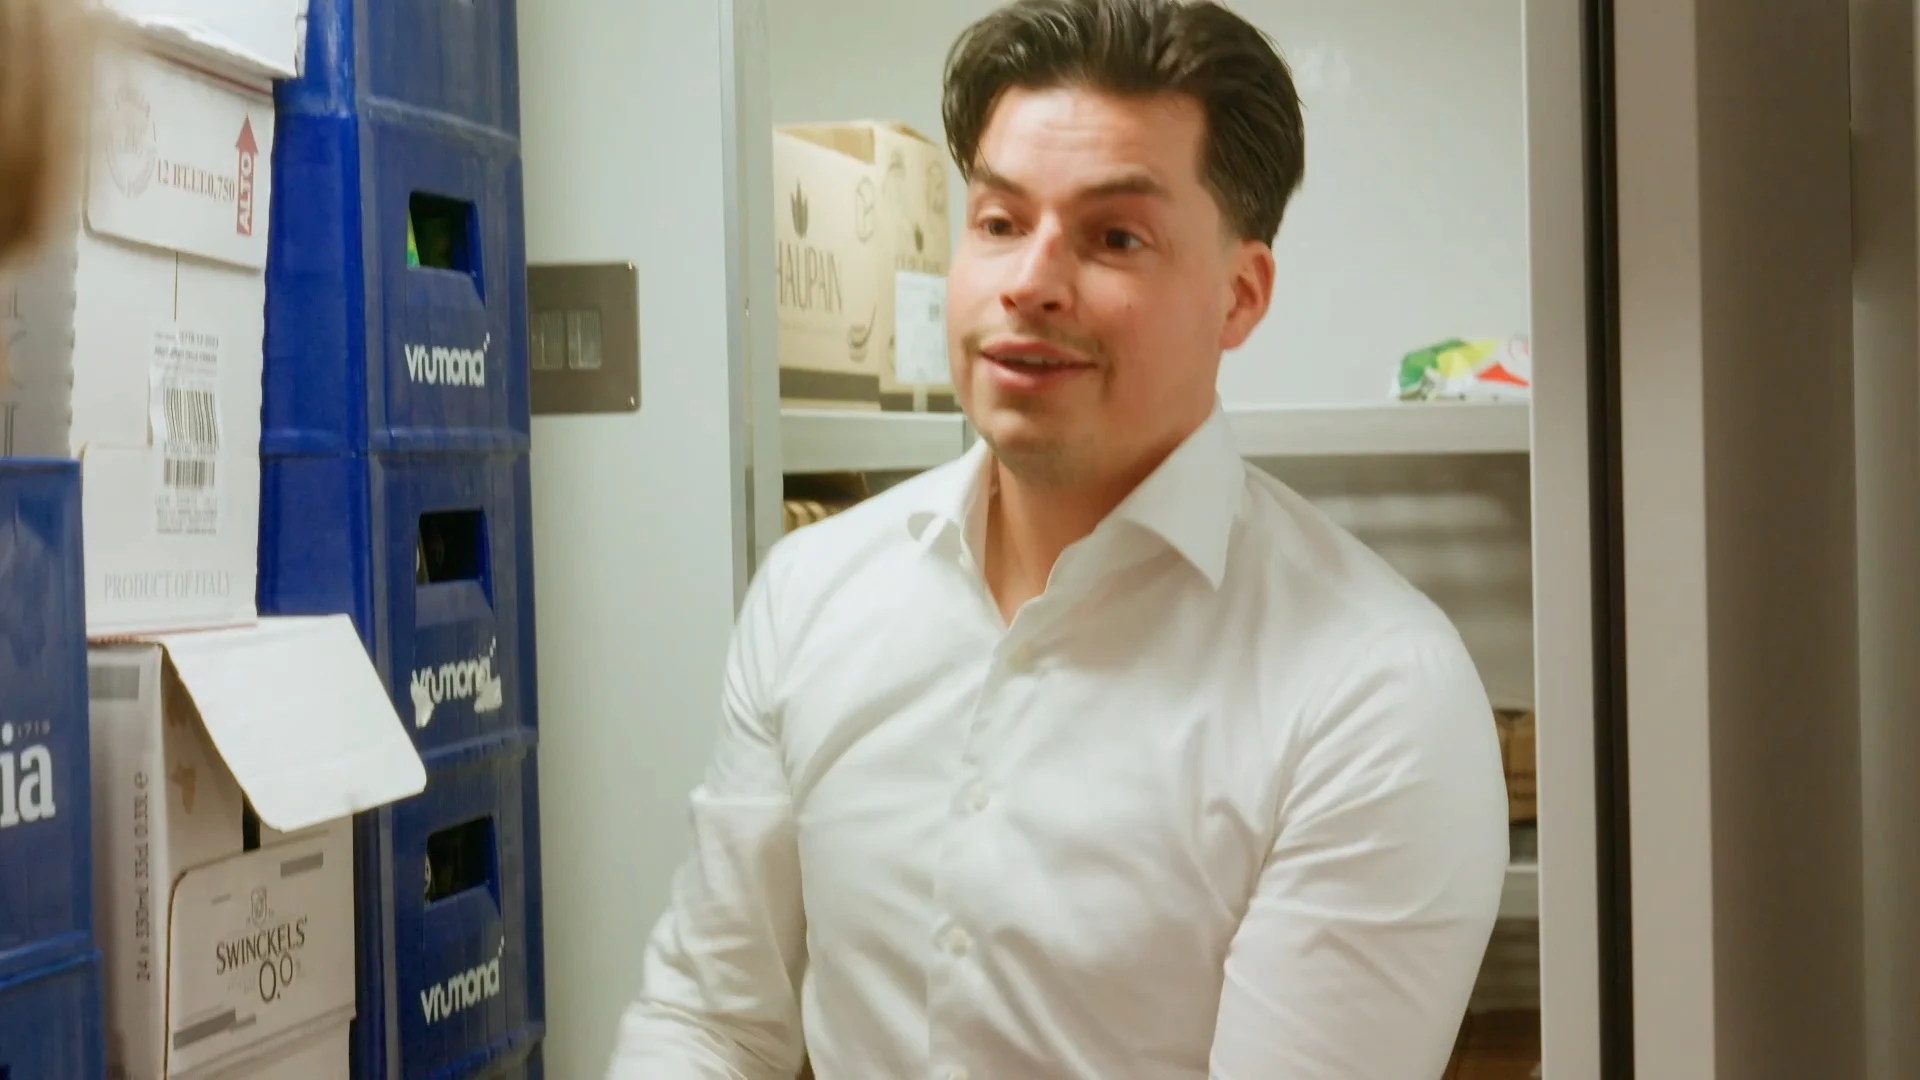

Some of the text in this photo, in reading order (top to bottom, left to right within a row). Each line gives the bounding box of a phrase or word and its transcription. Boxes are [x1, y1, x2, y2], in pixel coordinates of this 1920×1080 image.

[157, 158, 169, 186] 12
[240, 151, 253, 232] ALTO
[404, 343, 485, 388] vrumona
[104, 569, 231, 601] PRODUCT OF ITALY
[420, 957, 500, 1026] vrumona
